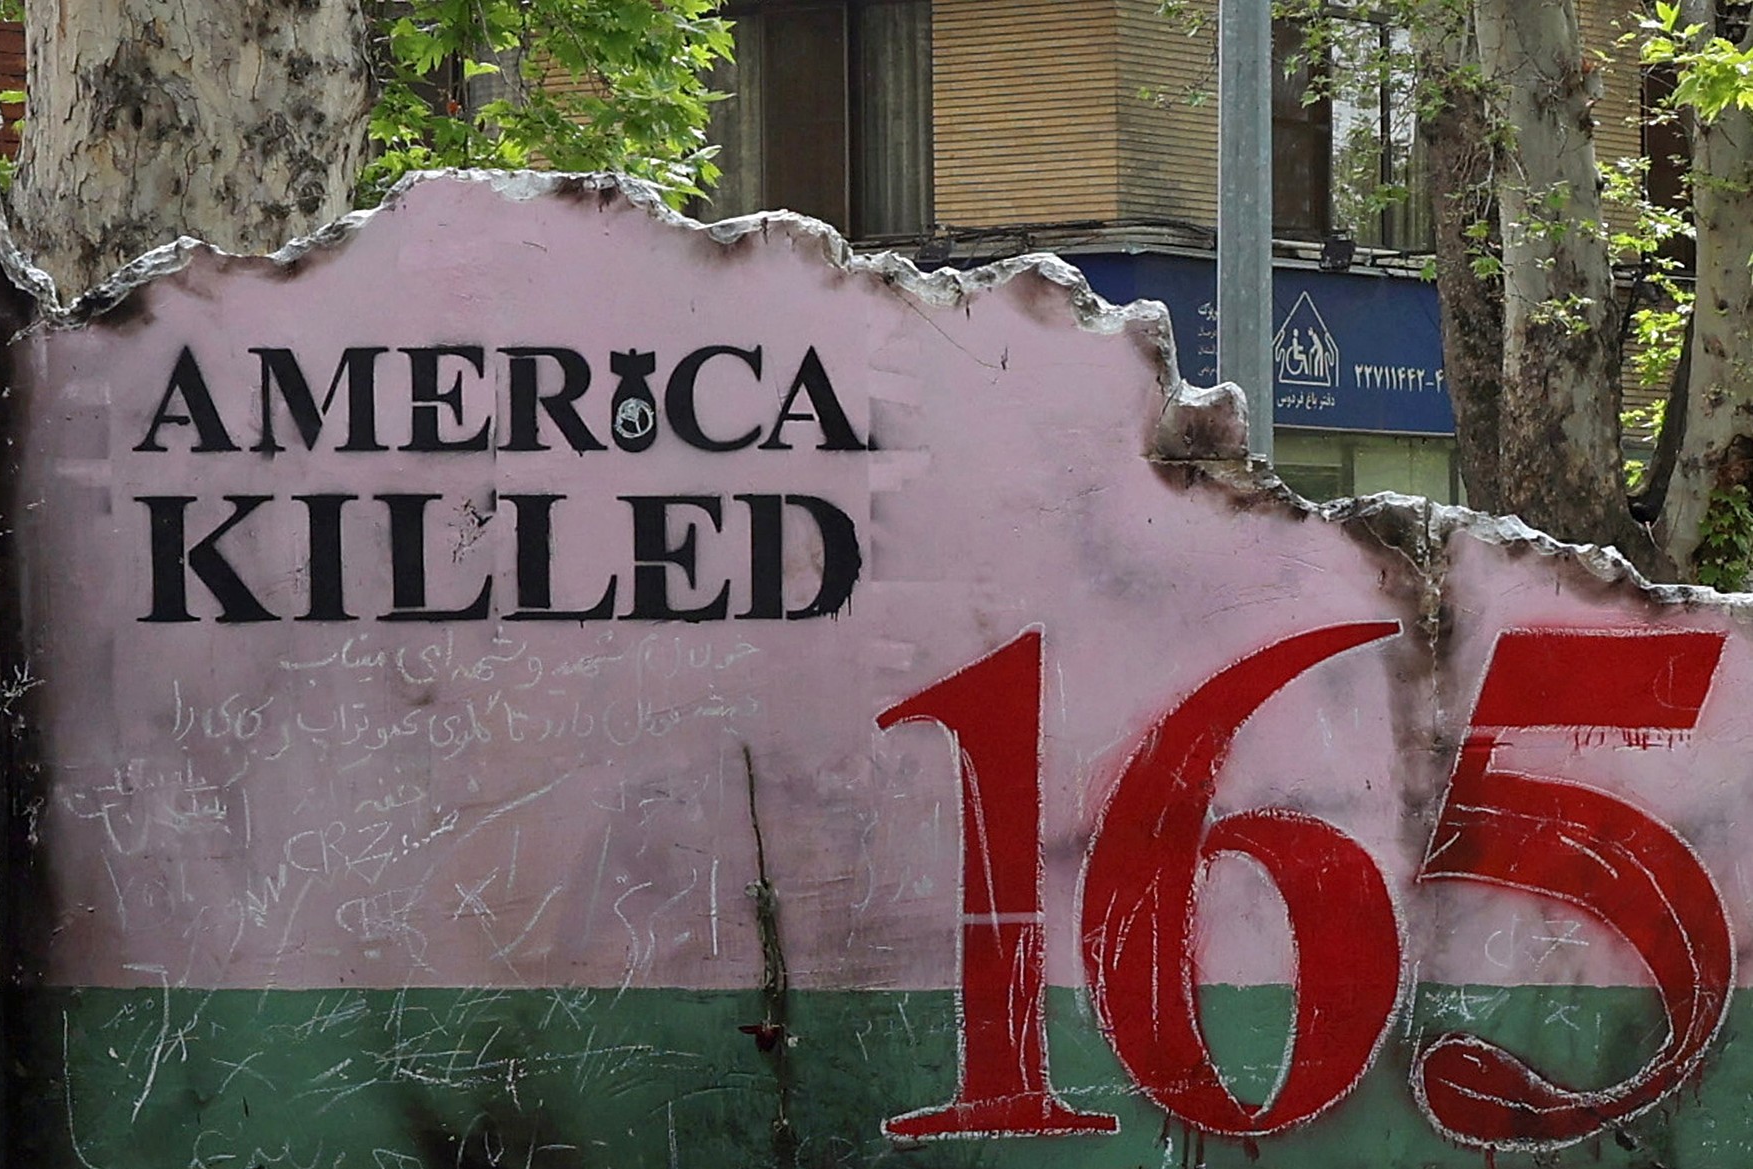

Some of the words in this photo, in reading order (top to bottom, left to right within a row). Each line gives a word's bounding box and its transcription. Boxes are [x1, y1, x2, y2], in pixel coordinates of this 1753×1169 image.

[132, 346, 870, 453] AMERICA
[133, 494, 863, 625] KILLED
[875, 619, 1738, 1152] 165
